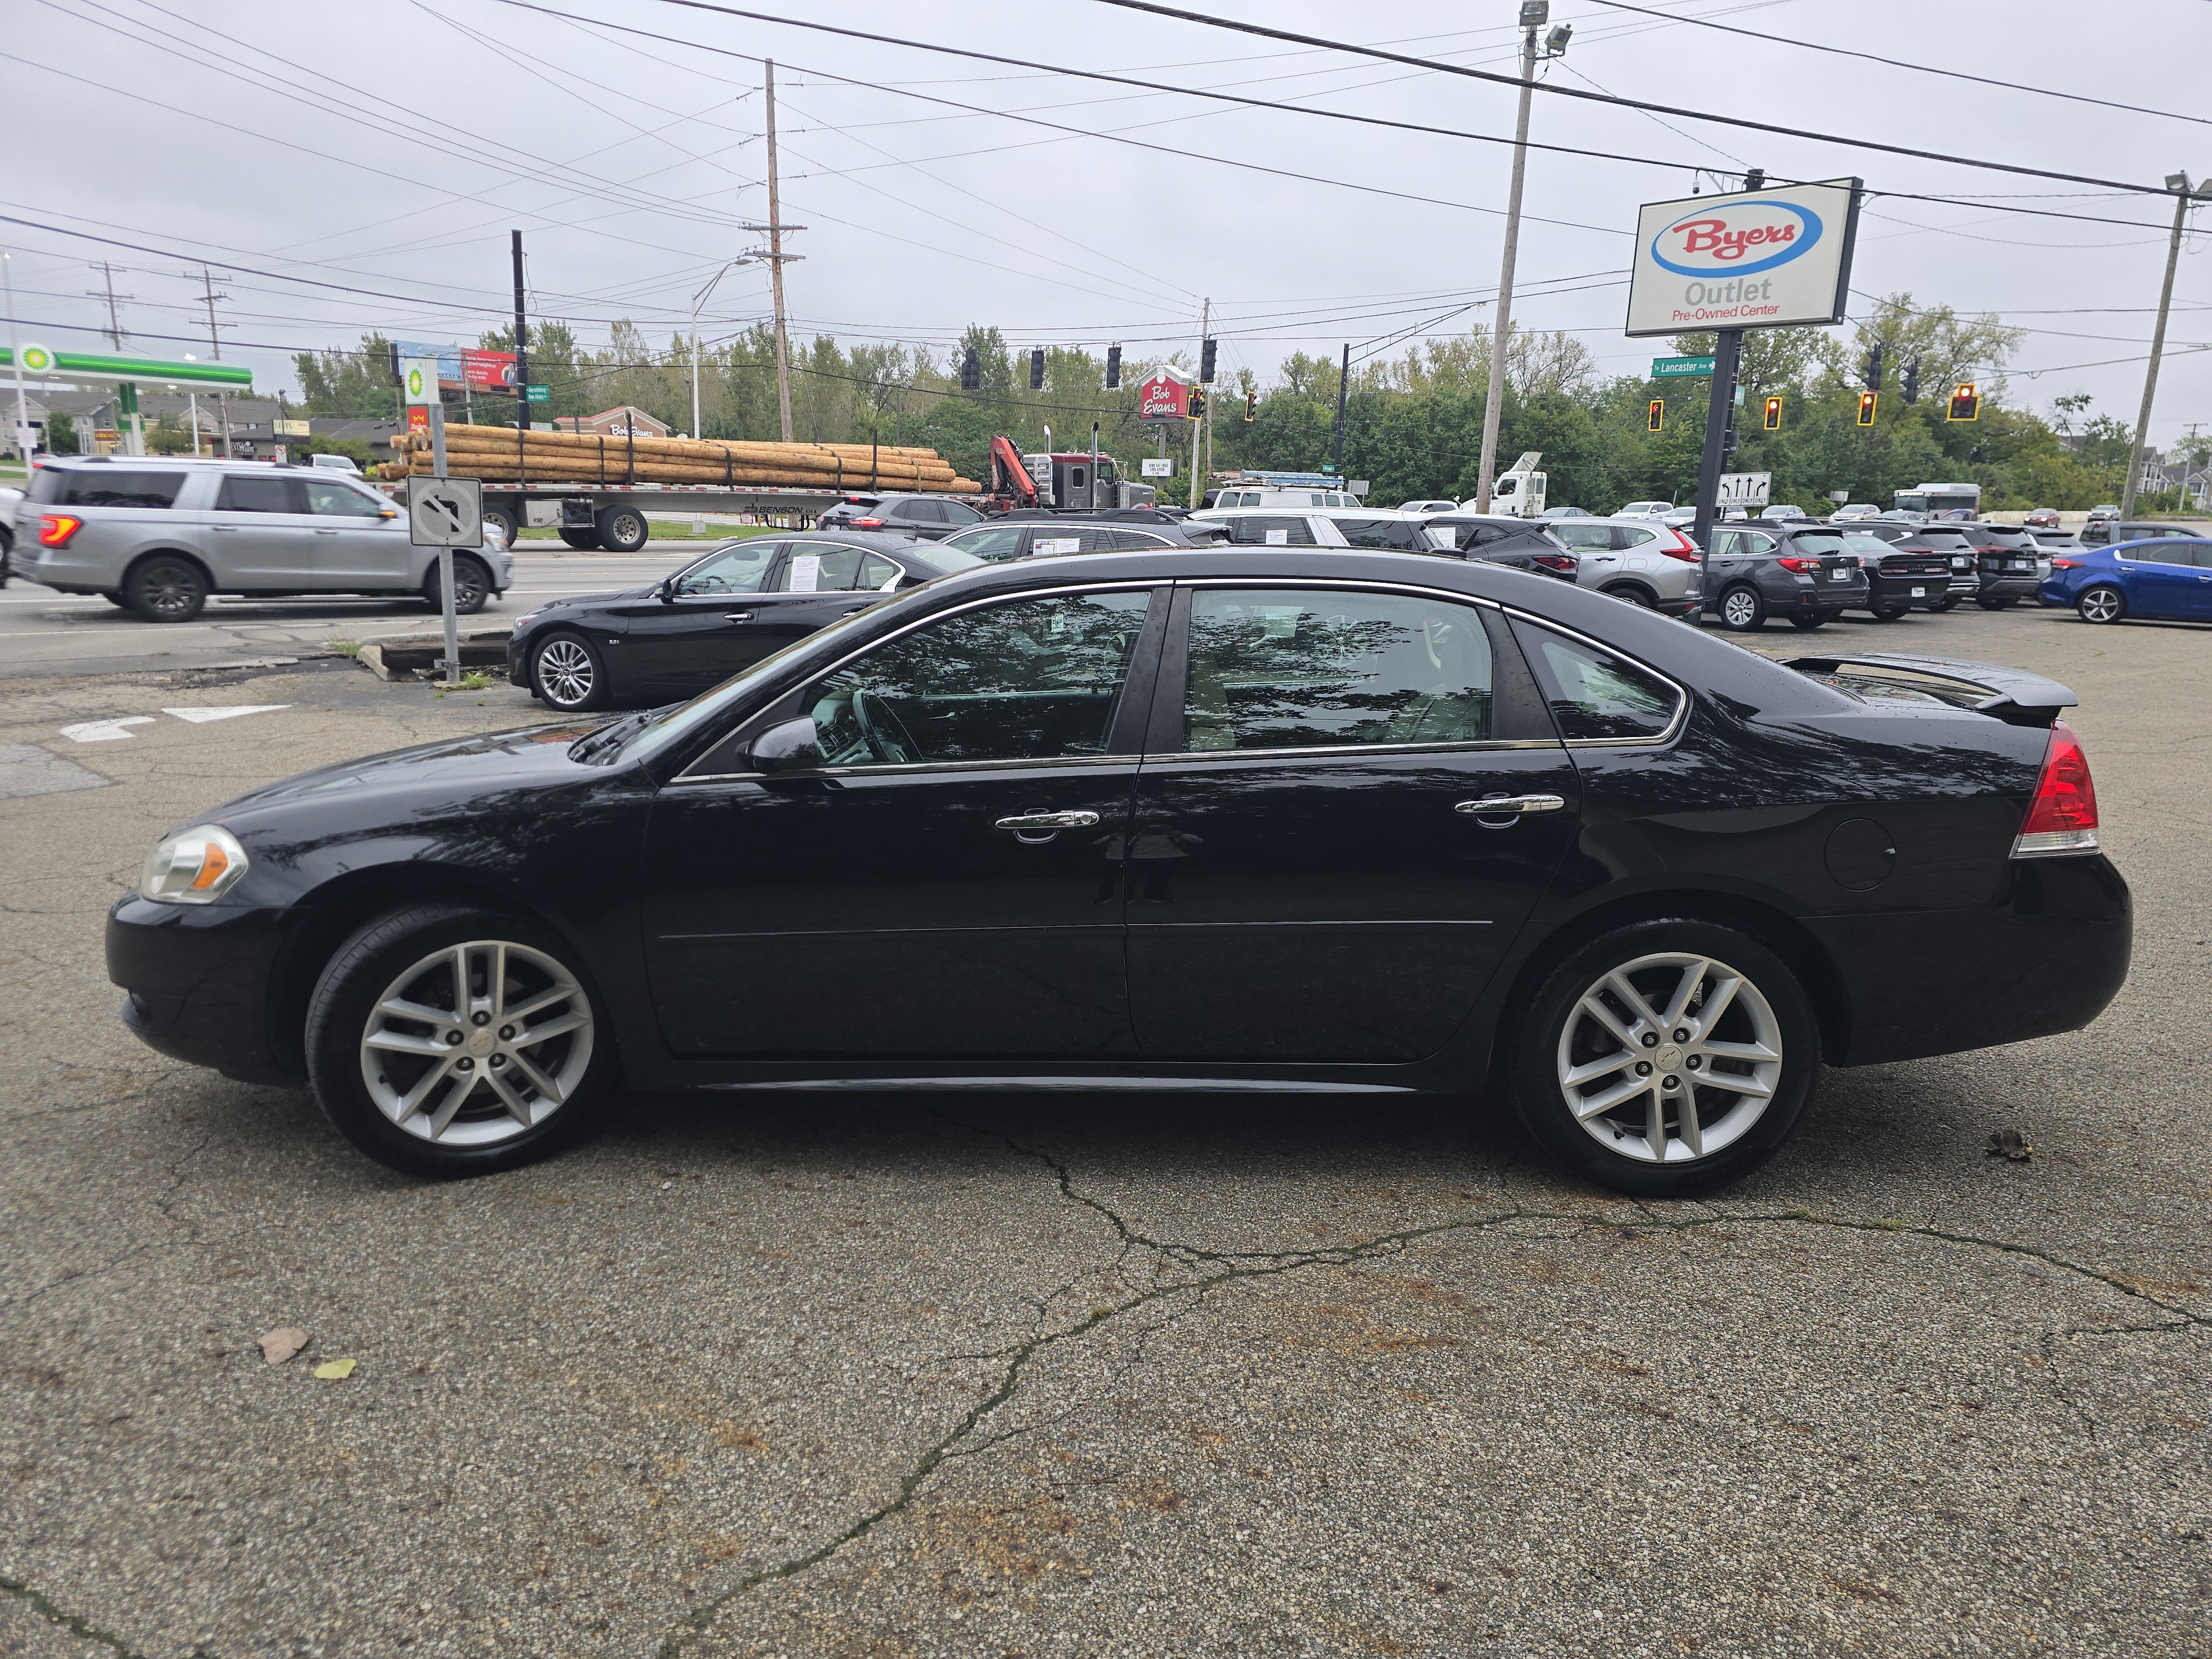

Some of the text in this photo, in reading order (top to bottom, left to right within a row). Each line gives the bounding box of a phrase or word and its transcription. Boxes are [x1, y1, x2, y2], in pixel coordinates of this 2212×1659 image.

[1672, 220, 1795, 260] Byers
[1684, 278, 1772, 306] Outlet
[1672, 304, 1780, 321] Pre-Owned Center
[1661, 362, 1697, 373] Lancaster
[1151, 385, 1170, 400] Bob
[1143, 398, 1177, 414] Evans
[609, 424, 653, 437] Bob Evans
